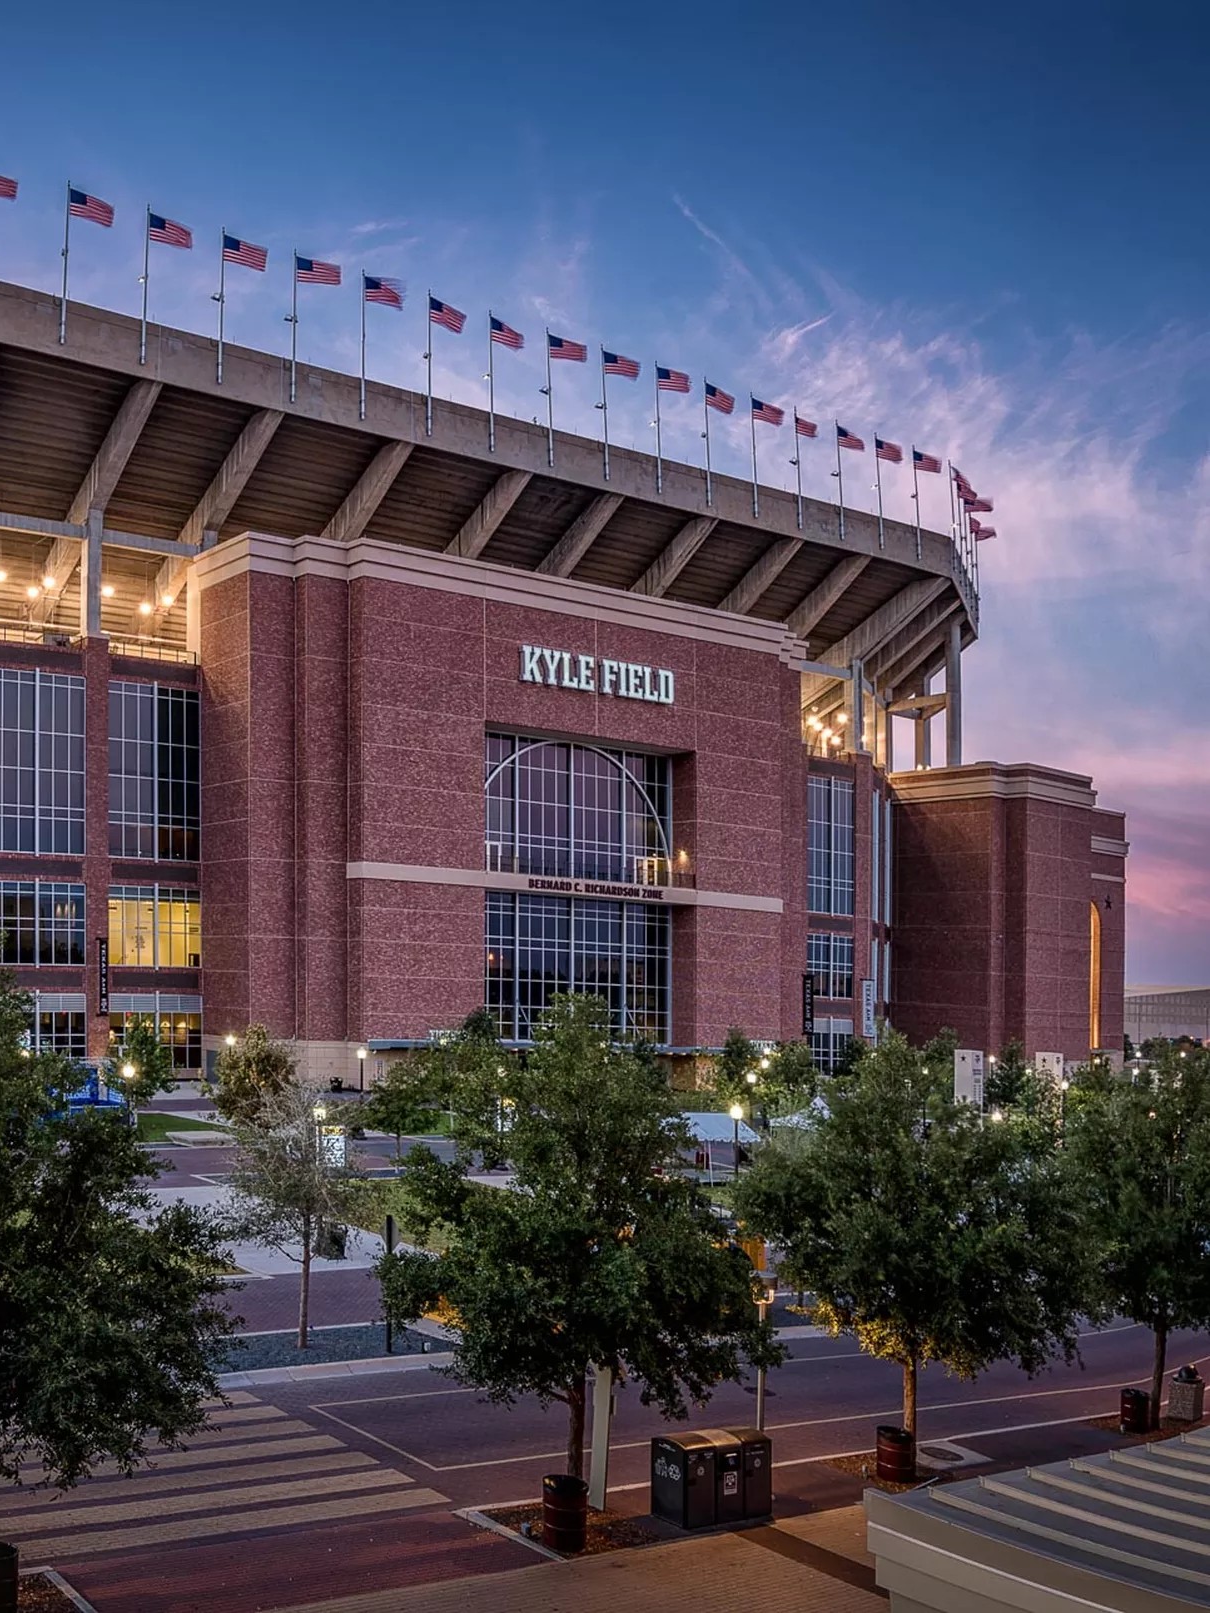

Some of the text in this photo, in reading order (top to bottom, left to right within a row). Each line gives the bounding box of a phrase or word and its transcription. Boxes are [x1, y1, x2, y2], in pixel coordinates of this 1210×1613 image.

[520, 644, 675, 705] KYLE FIELD
[528, 878, 665, 900] BERNARD C. RICHARDSON ZONE
